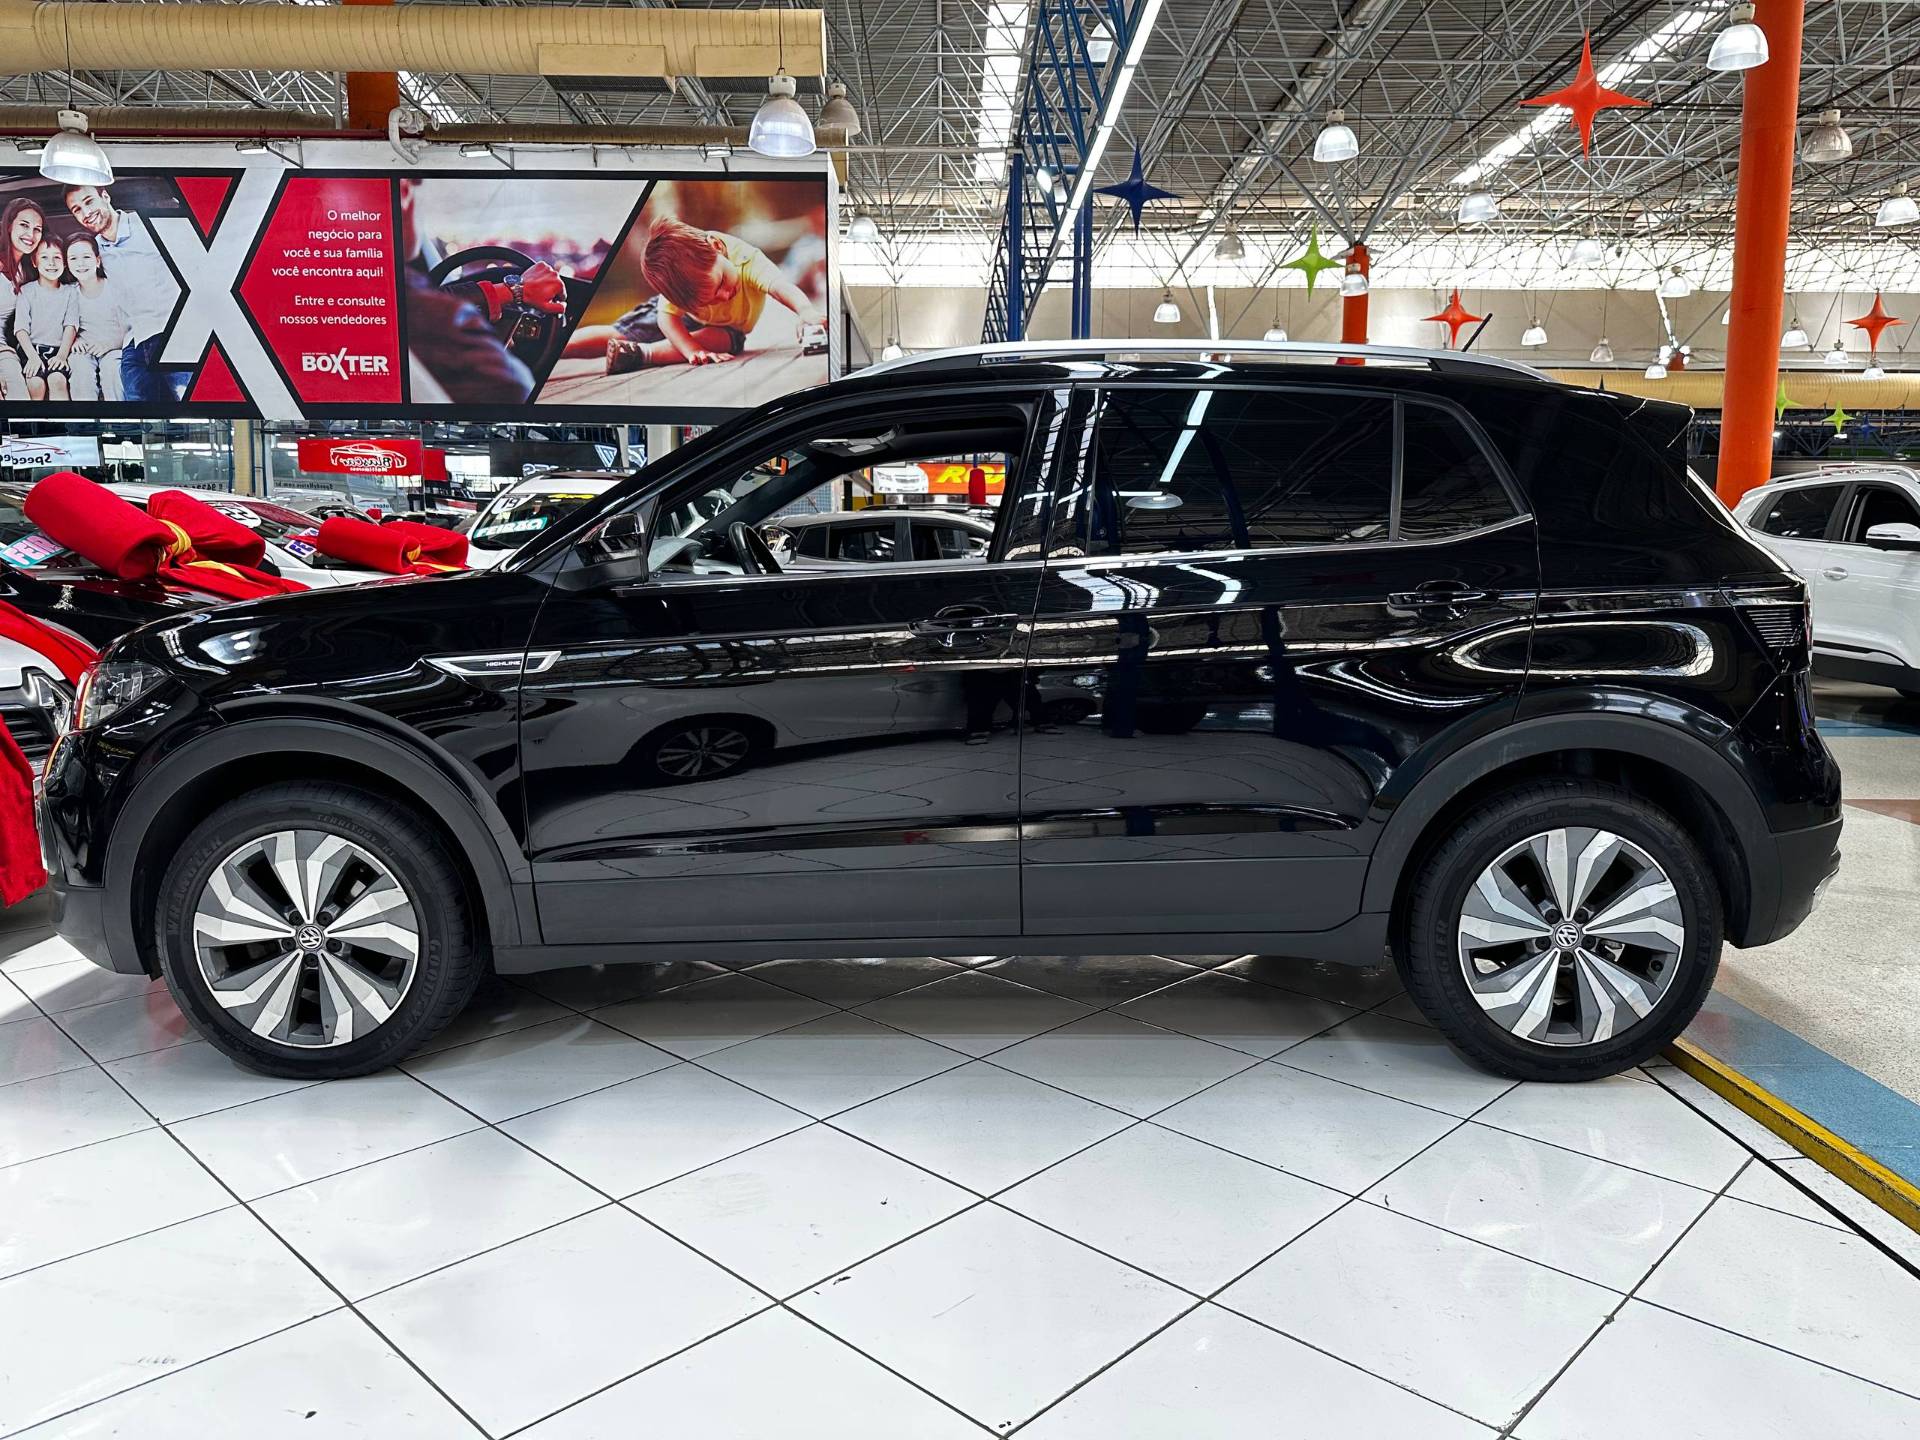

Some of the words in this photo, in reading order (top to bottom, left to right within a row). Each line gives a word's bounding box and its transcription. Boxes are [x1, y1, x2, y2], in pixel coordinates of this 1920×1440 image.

[327, 210, 338, 221] O
[341, 210, 382, 221] melhor
[308, 229, 355, 242] negócio
[357, 231, 382, 242] para
[283, 247, 311, 258] você
[313, 250, 321, 258] e
[323, 250, 343, 258] sua
[346, 247, 383, 258] família
[272, 265, 299, 276] você
[302, 267, 353, 277] encontra
[356, 266, 384, 279] aqui!
[295, 295, 325, 306] Entre
[327, 298, 335, 306] e
[337, 295, 386, 306] consulte
[280, 316, 319, 325] nossos
[320, 314, 387, 325] vendedores
[302, 347, 389, 380] BOXTER
